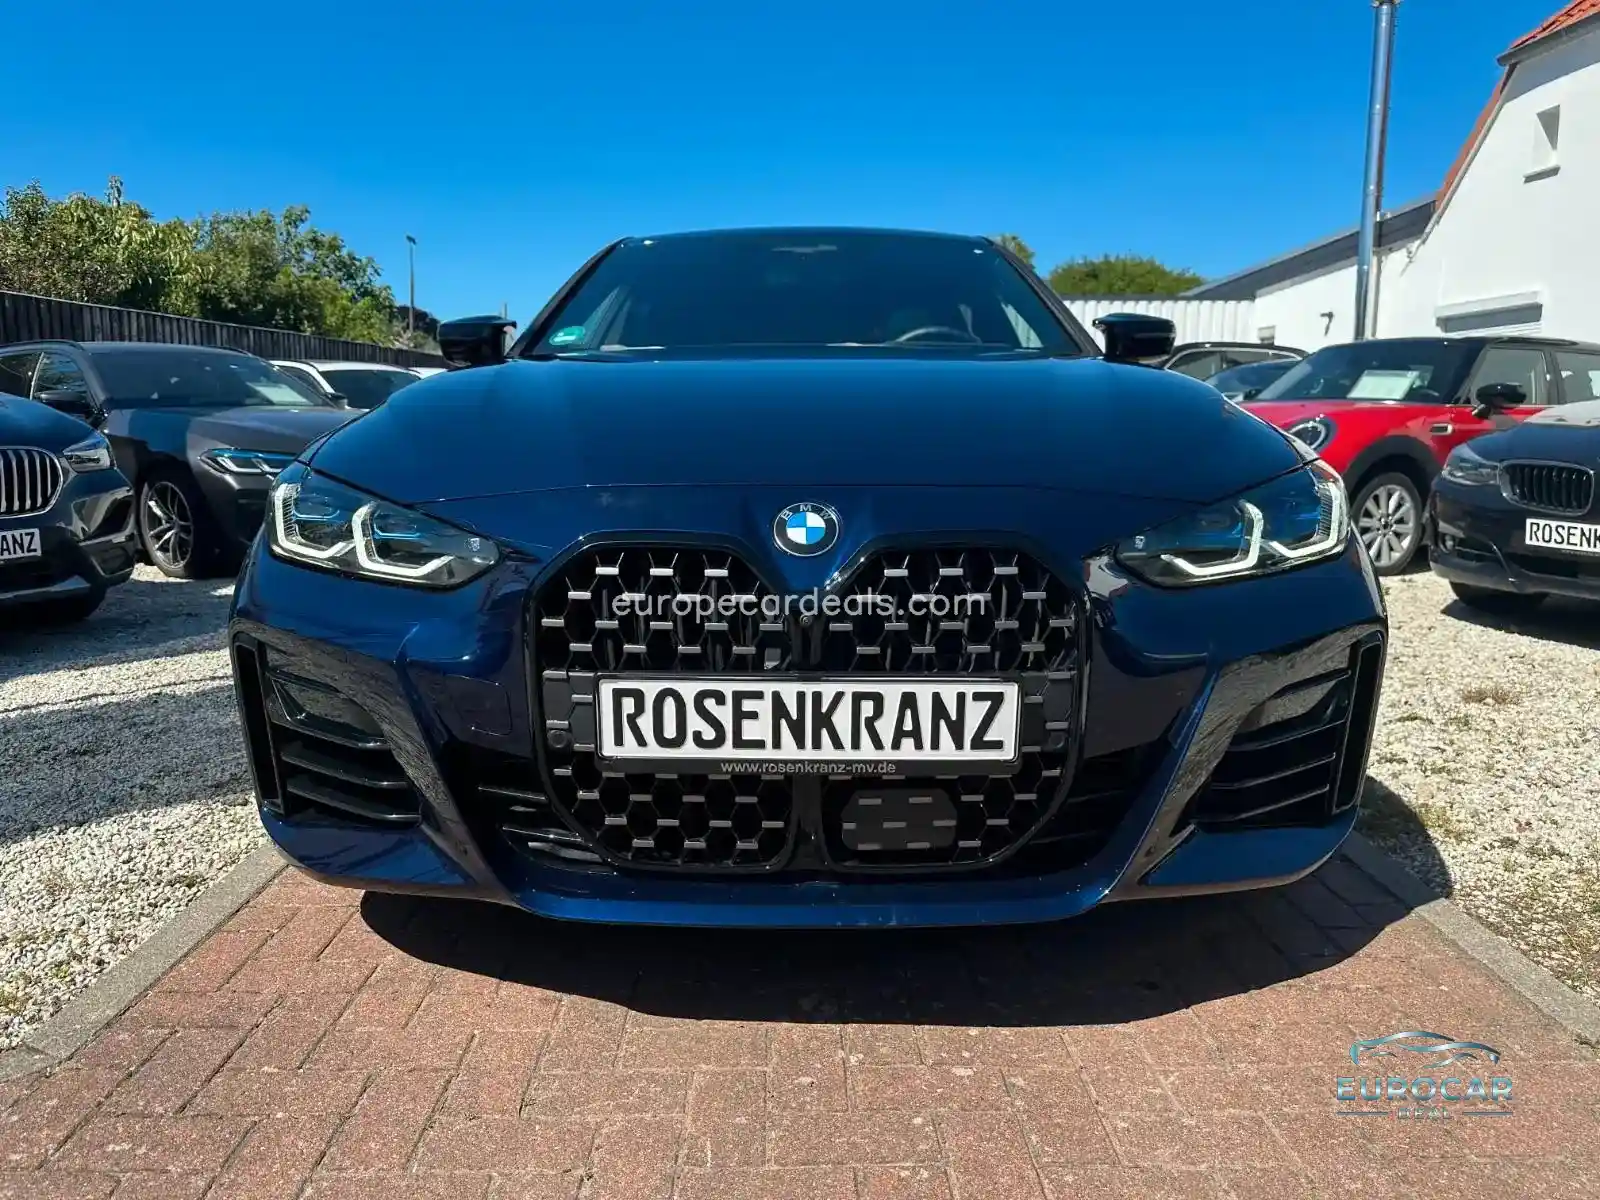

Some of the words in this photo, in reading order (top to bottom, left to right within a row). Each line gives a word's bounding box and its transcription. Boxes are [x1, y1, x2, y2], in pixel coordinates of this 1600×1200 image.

[780, 504, 832, 520] BMW
[611, 687, 1005, 751] ROSENKRANZ
[720, 761, 897, 774] www.rosenkranz-mv.de
